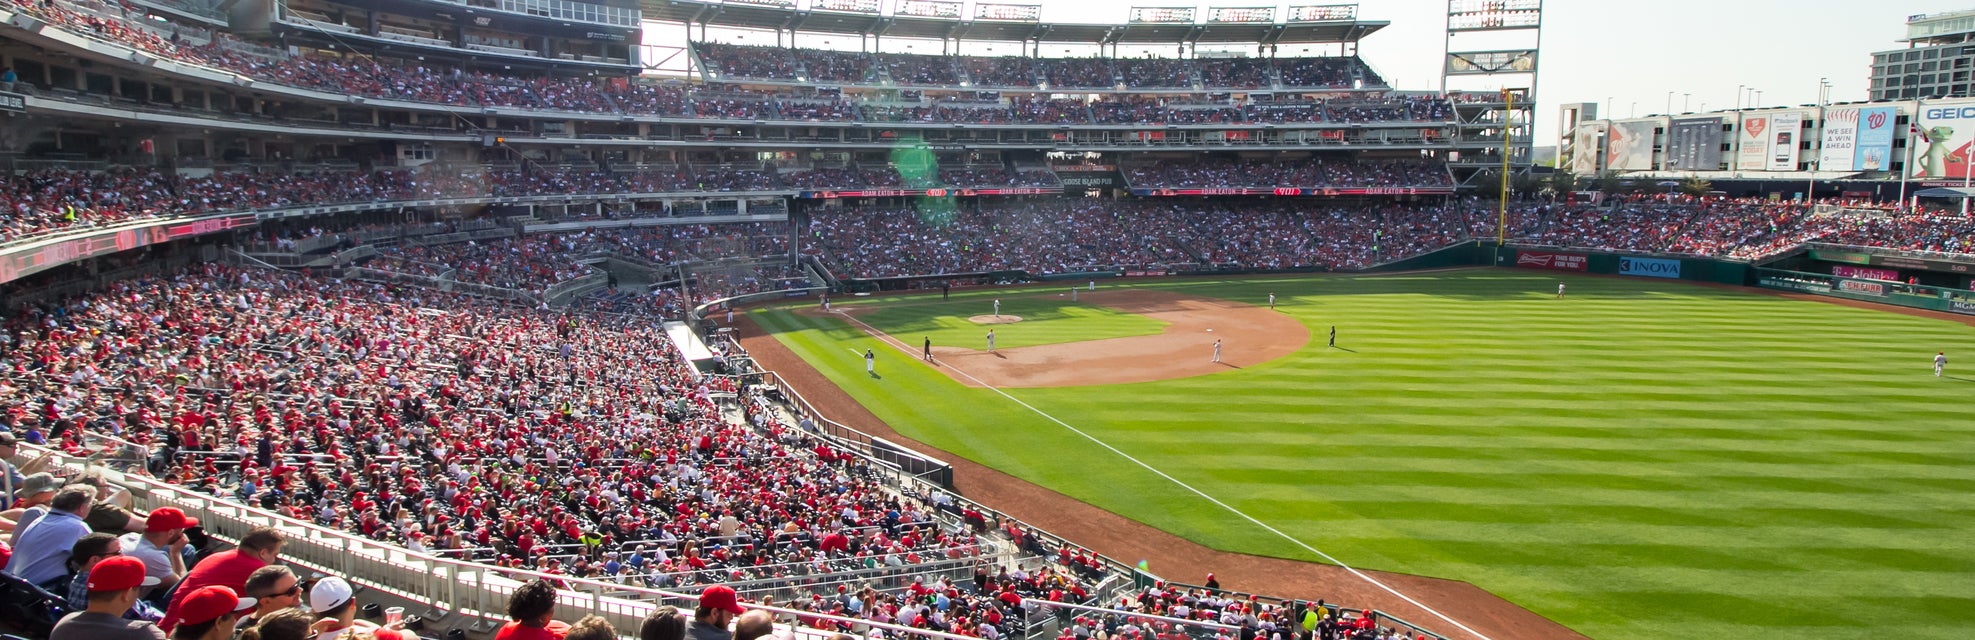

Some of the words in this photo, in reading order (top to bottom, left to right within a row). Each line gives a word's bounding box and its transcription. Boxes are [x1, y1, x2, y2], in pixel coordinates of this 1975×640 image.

[1868, 111, 1886, 130] W
[1555, 254, 1568, 262] THIS
[1634, 261, 1678, 274] INOVA
[1860, 283, 1881, 291] FURR
